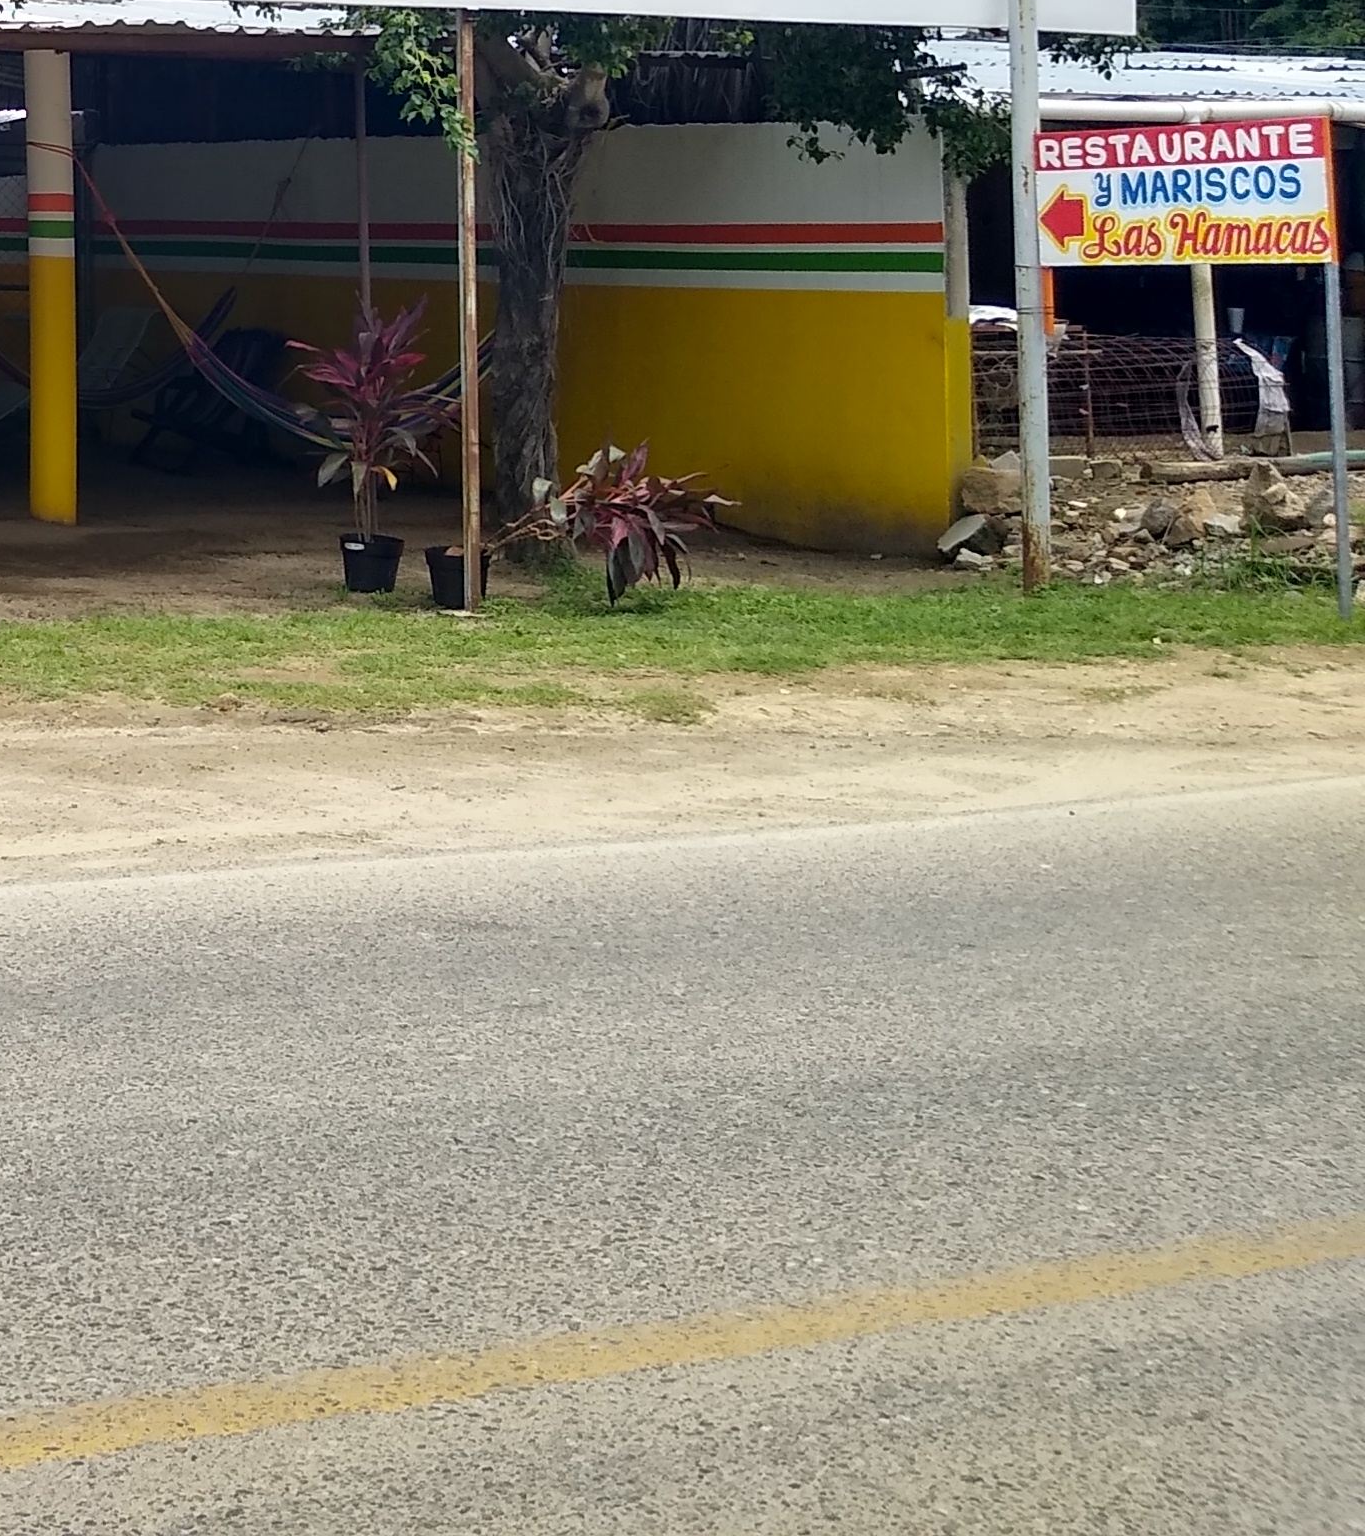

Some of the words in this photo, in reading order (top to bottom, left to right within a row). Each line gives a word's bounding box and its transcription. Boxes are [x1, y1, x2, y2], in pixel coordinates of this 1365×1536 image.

[1038, 122, 1315, 169] RESTAURANTE
[1120, 162, 1302, 206] MARISCOS
[1082, 214, 1163, 260] Las
[1169, 210, 1331, 257] Hamacas
